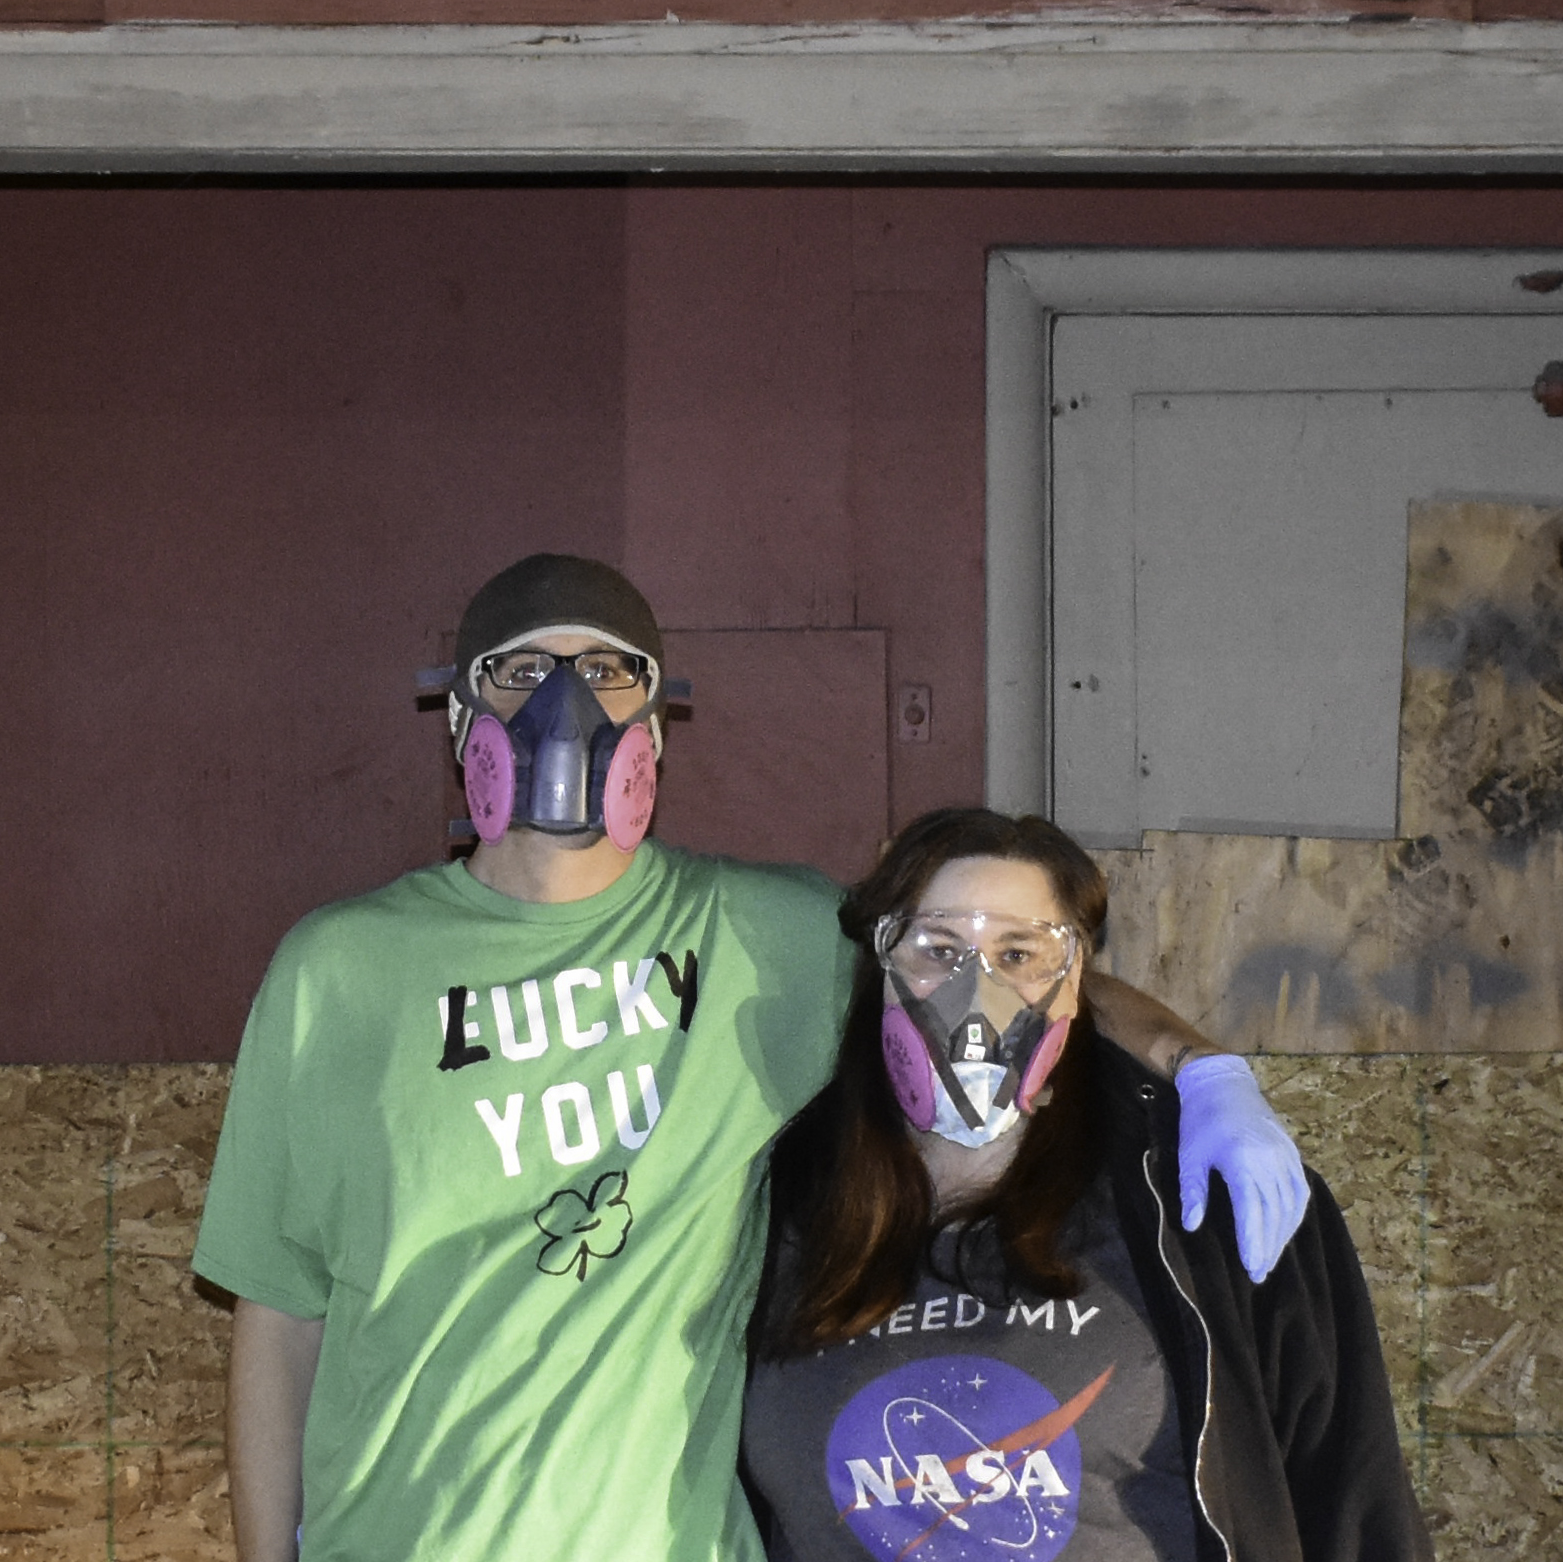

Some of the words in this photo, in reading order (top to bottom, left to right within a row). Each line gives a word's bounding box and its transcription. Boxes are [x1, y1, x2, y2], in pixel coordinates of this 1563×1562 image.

[437, 949, 698, 1071] LUCKY
[474, 1064, 661, 1177] YOU
[1005, 1297, 1101, 1336] MY
[845, 1449, 1070, 1510] NASA
